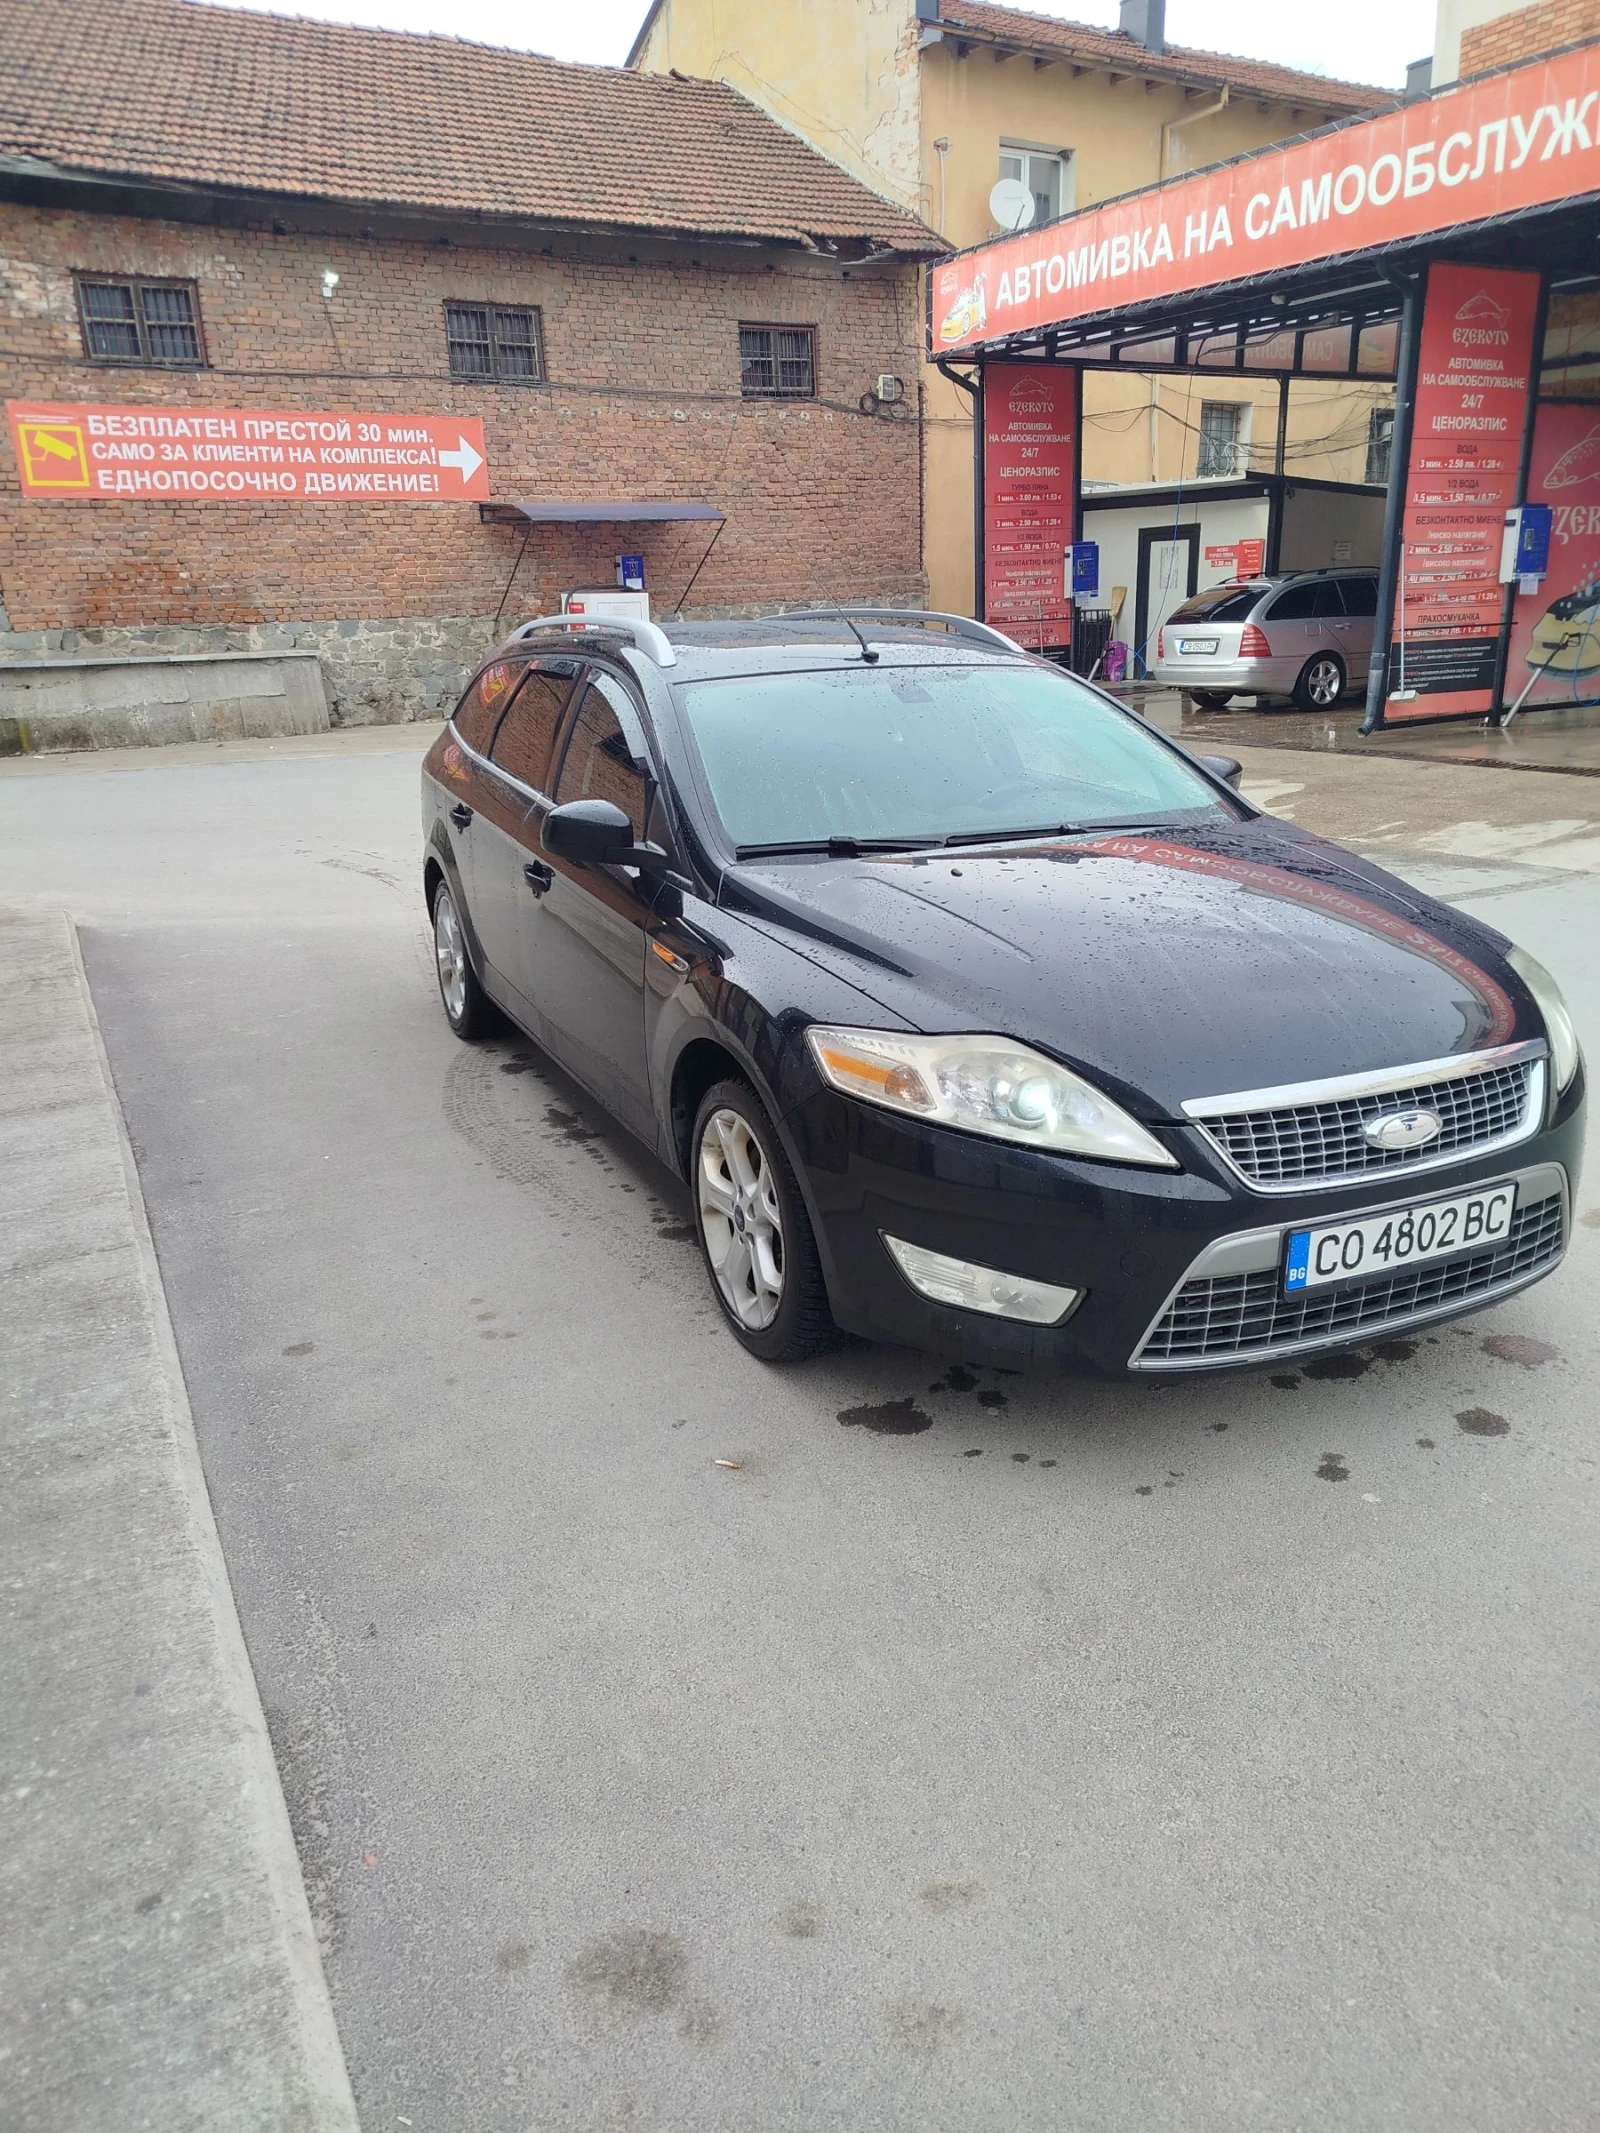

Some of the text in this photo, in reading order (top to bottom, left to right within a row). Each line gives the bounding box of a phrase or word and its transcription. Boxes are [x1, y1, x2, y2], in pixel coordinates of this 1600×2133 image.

[995, 91, 1600, 310] АВТОМИВКА НА САМООБСЛУЖ
[1448, 358, 1504, 371] АВТОМИВКА
[1422, 373, 1525, 388] НА САМООБСЛУЖВАНЕ
[1461, 394, 1484, 408] 24/7
[87, 415, 237, 439] БЕЗПЛАТЕН
[243, 419, 352, 442] ПРЕСТОЙ
[357, 423, 381, 442] 30
[387, 428, 434, 443] мин.
[1008, 422, 1052, 430] АВТОМИВКА
[1432, 416, 1507, 431] ЦЕНОРАЗПИС
[989, 434, 1071, 442] НА САМООБСЛУЖВАНЕ
[92, 443, 437, 465] САМО ЗА КЛИЕНТИ НА КОМПЛЕКСА!
[1022, 448, 1039, 458] 24/7
[1457, 445, 1478, 455] ВОДА
[1420, 460, 1424, 468] 3
[1000, 466, 1060, 478] ЦЕНОРАЗПИС
[97, 469, 440, 495] ЕДНОПОСОЧНО ДВИЖЕНИЕ!
[1459, 480, 1479, 489] ВОДА
[1416, 515, 1500, 524] БЕЗКОНТАКТНО МИЕНЕ
[1417, 612, 1480, 623] ПРАХОСМУКАЧКА
[1315, 1194, 1507, 1276] CO 4802 BC
[1289, 1267, 1306, 1281] BG
